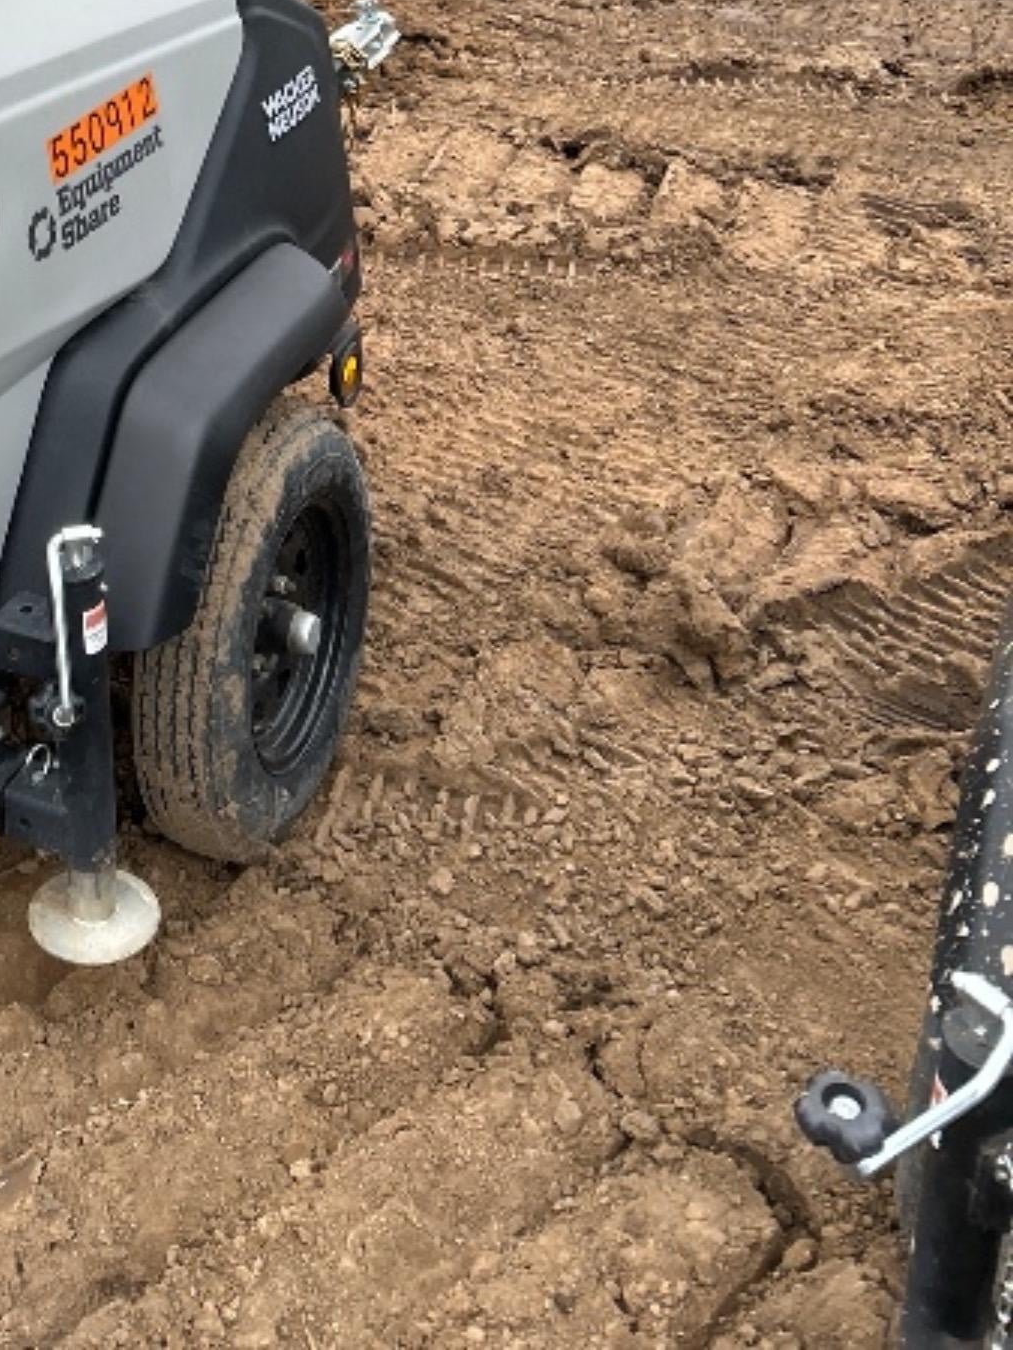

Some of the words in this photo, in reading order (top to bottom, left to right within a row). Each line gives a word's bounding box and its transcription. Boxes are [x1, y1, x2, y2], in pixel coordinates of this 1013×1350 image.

[261, 65, 316, 119] WACKER
[269, 83, 321, 142] NEUSON
[51, 77, 158, 179] 550912
[56, 125, 163, 217] Equipment
[61, 193, 121, 250] Share
